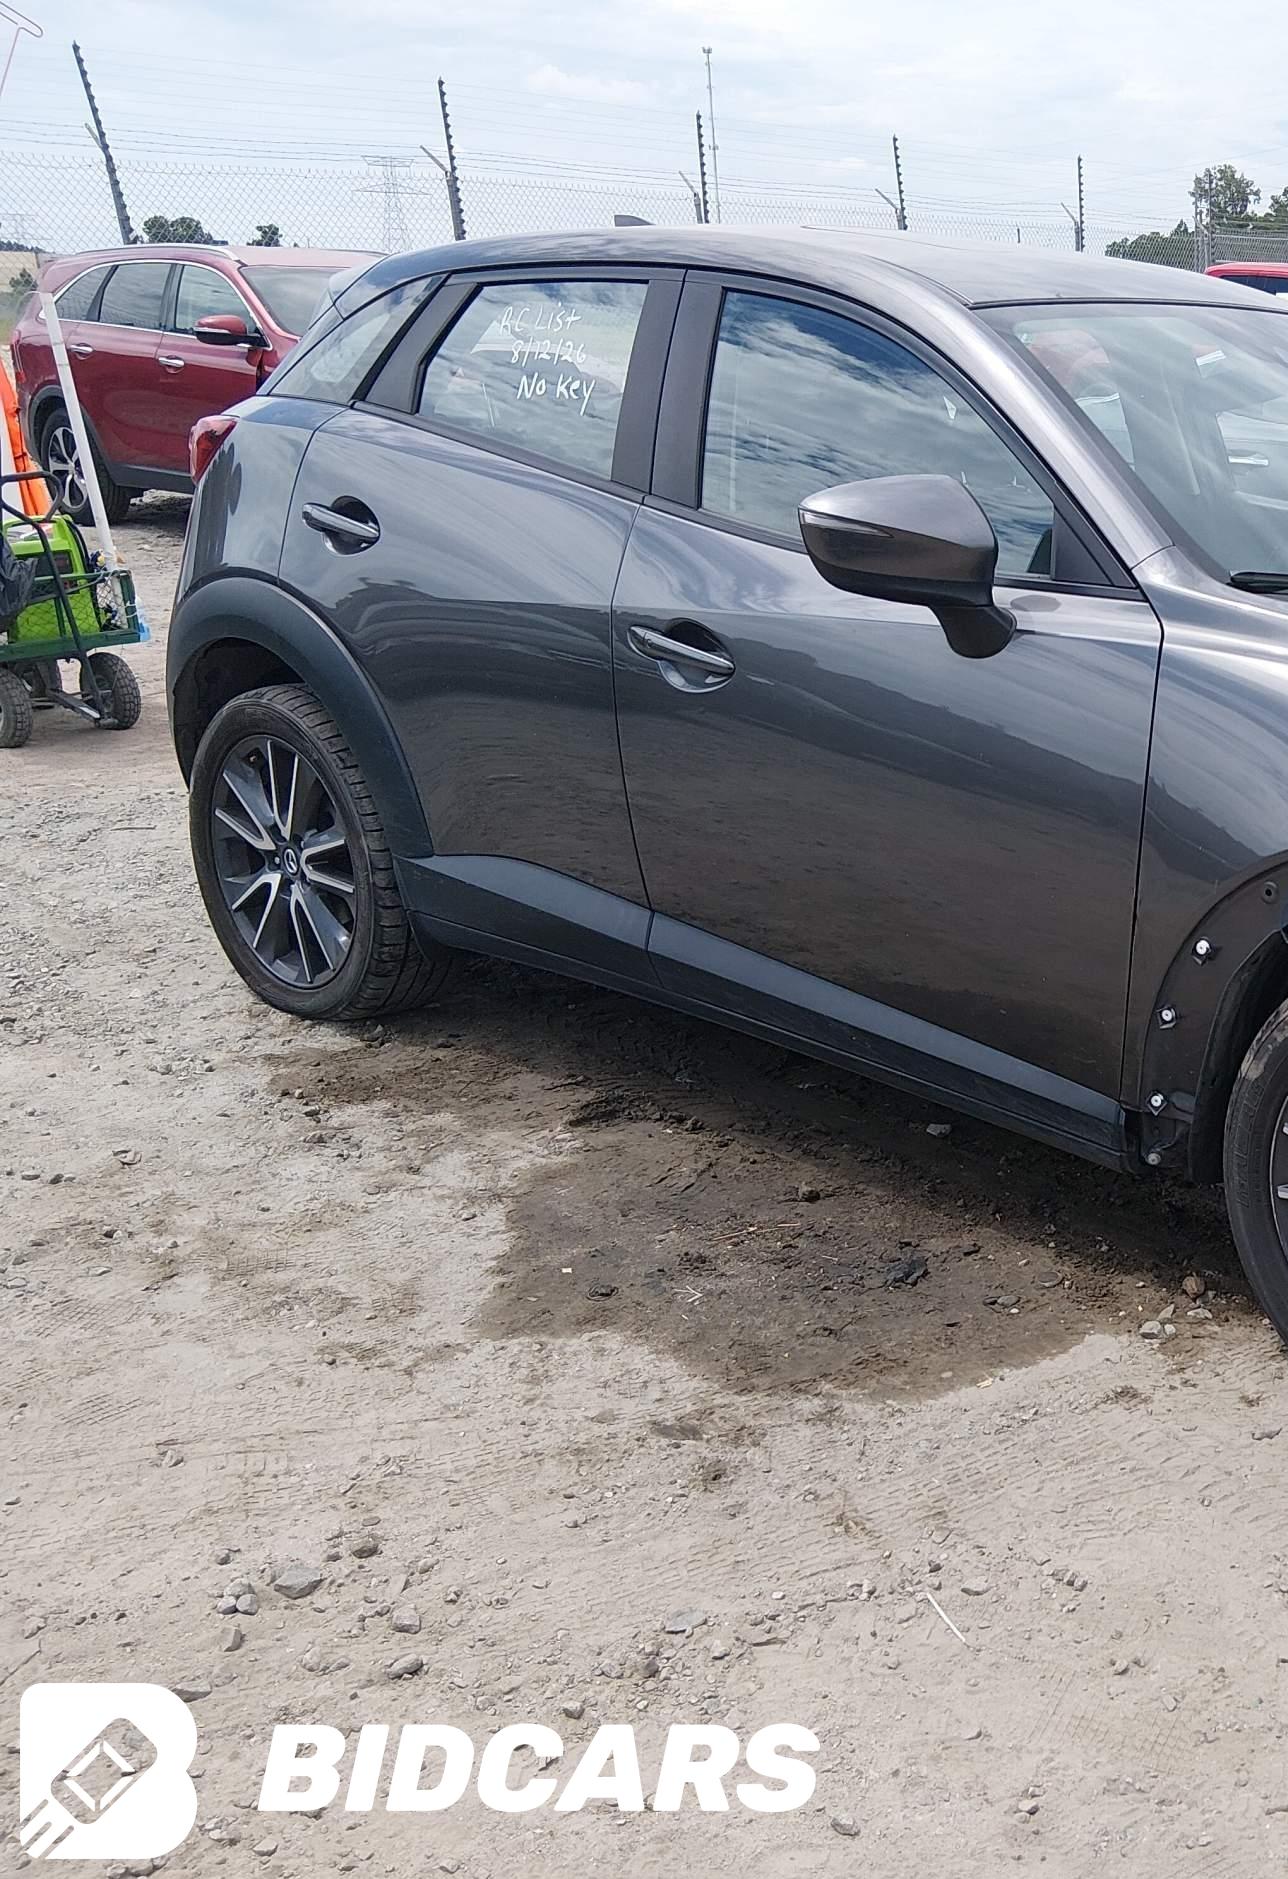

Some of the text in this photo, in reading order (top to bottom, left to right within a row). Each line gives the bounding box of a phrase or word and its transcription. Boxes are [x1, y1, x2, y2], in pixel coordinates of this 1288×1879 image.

[511, 336, 586, 367] 8/12/26
[517, 372, 596, 416] No Key
